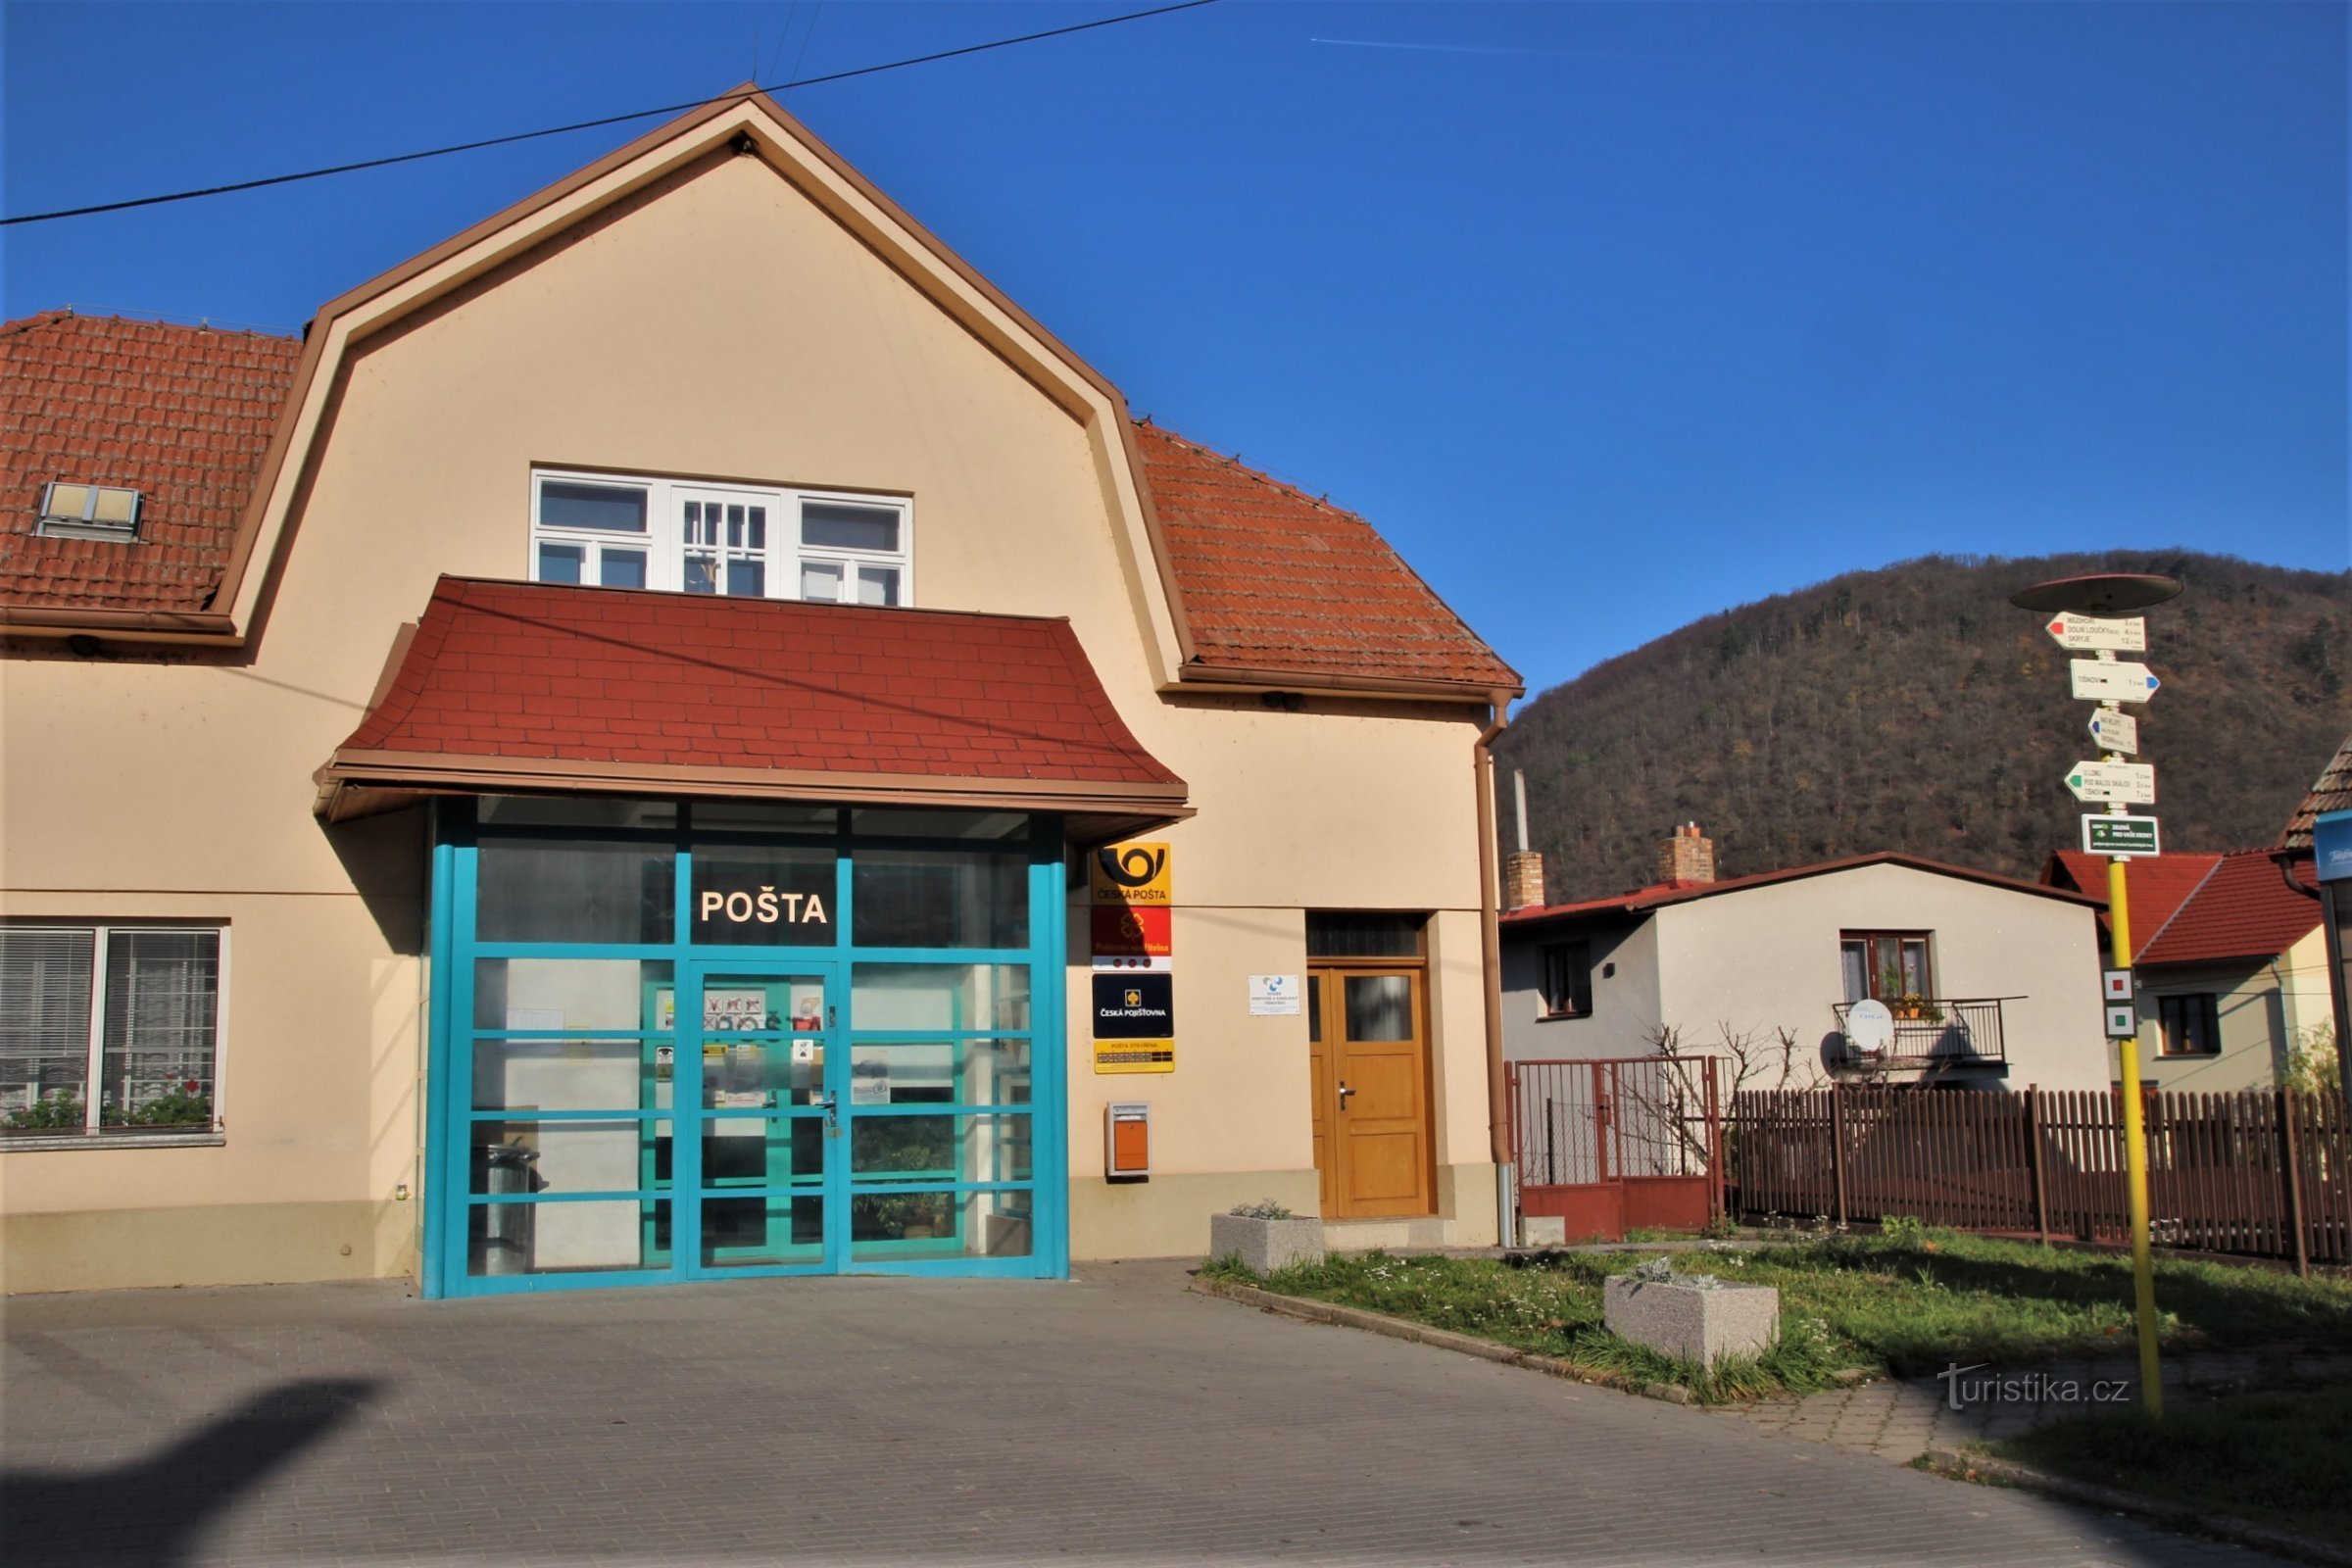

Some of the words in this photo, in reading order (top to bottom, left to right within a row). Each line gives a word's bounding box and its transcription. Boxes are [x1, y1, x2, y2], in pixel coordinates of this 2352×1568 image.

[1098, 888, 1132, 900] ČESKÁ
[1133, 888, 1166, 900] POŠTA
[702, 885, 828, 924] POŠTA
[1100, 1007, 1124, 1017] ČESKÁ
[1124, 1007, 1166, 1017] POJIŠŤOVNA
